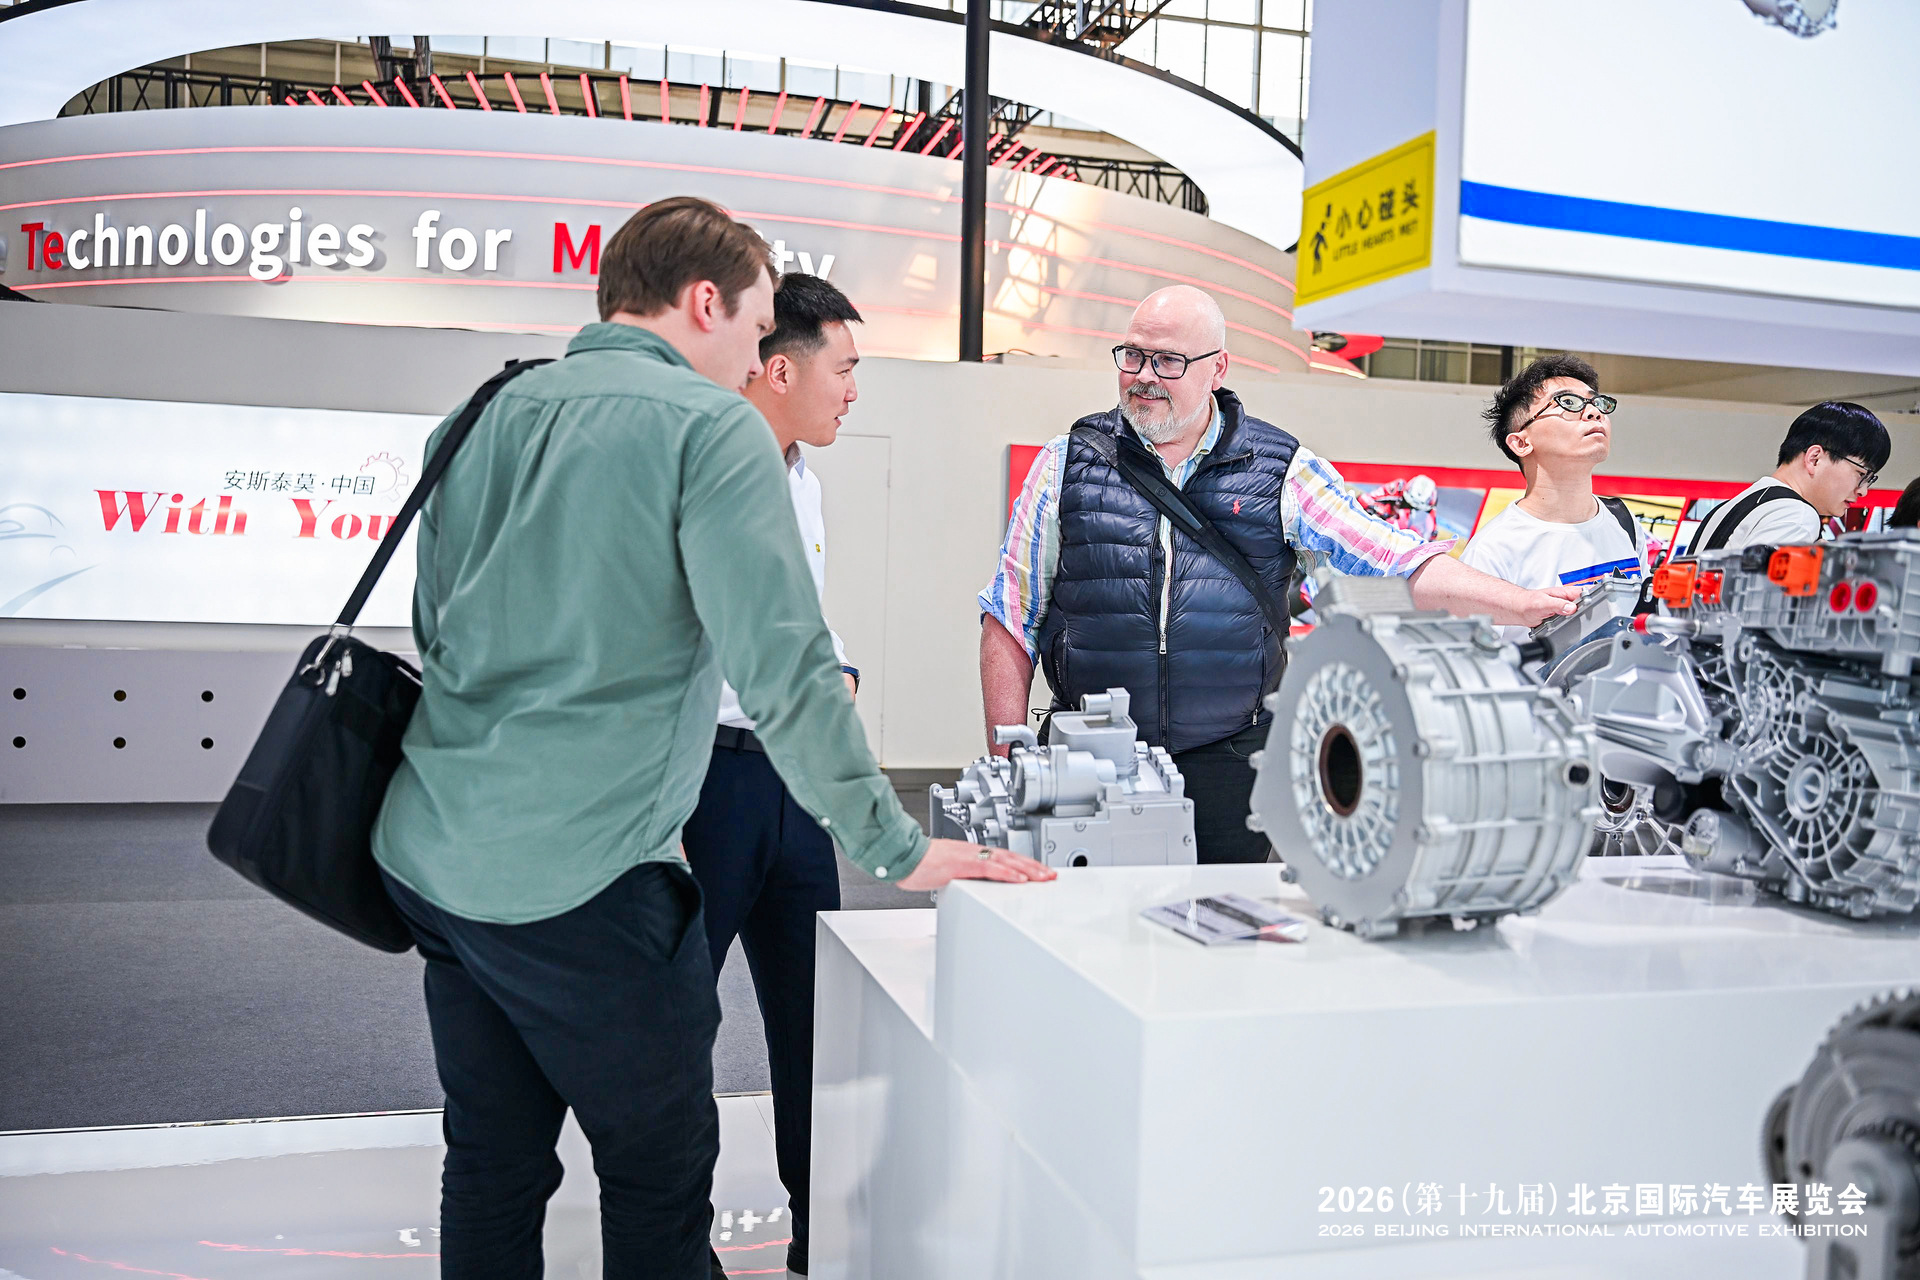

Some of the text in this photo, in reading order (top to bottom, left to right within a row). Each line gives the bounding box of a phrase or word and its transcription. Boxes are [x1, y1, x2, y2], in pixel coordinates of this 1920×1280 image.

[21, 206, 376, 281] Technologies
[412, 209, 513, 272] for
[93, 489, 398, 541] With You
